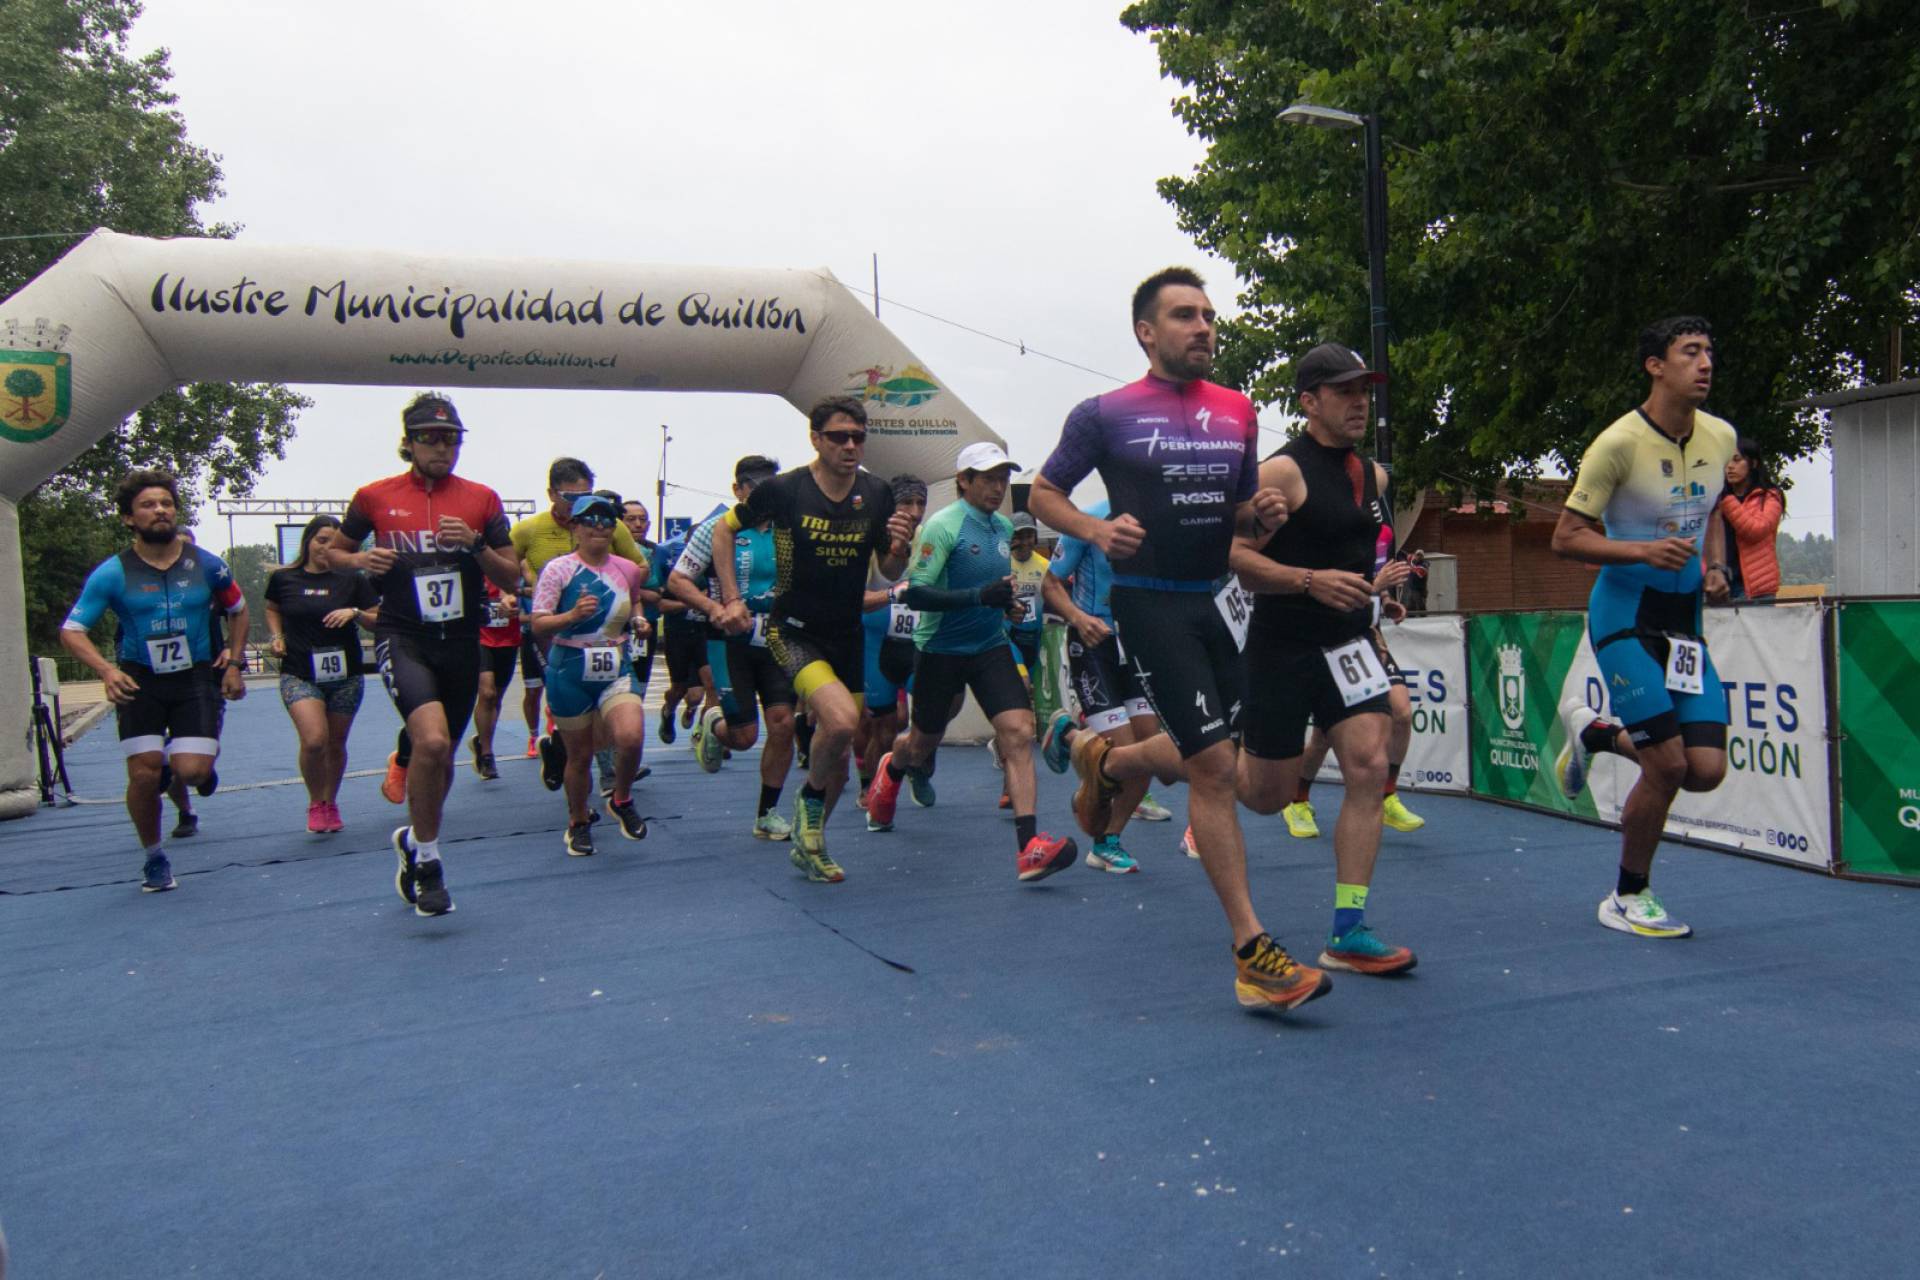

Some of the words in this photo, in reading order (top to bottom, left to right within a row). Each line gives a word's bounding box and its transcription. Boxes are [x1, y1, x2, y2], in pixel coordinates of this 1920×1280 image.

[304, 279, 604, 339] Municipalidad
[618, 292, 665, 326] de
[678, 292, 806, 334] Quillón
[389, 348, 618, 372] www.DeportesQuillon.cl
[867, 418, 905, 428] ORTES
[908, 416, 957, 428] QUILLÓN
[1162, 463, 1230, 476] ZEO
[801, 514, 831, 531] TRI
[1180, 516, 1222, 526] GARMIN
[815, 545, 859, 557] SILVA
[427, 578, 455, 608] 37
[894, 614, 915, 634] 89
[156, 640, 184, 664] 72
[591, 651, 614, 672] 56
[1674, 643, 1697, 676] 35
[321, 655, 341, 674] 49
[1338, 649, 1374, 686] 61
[1400, 669, 1447, 703] ES
[1411, 703, 1446, 735] ÓN
[1491, 748, 1540, 771] QUILLÓN
[1728, 732, 1802, 779] CIÓN
[1899, 788, 1920, 801] MU
[1898, 805, 1920, 832] Q
